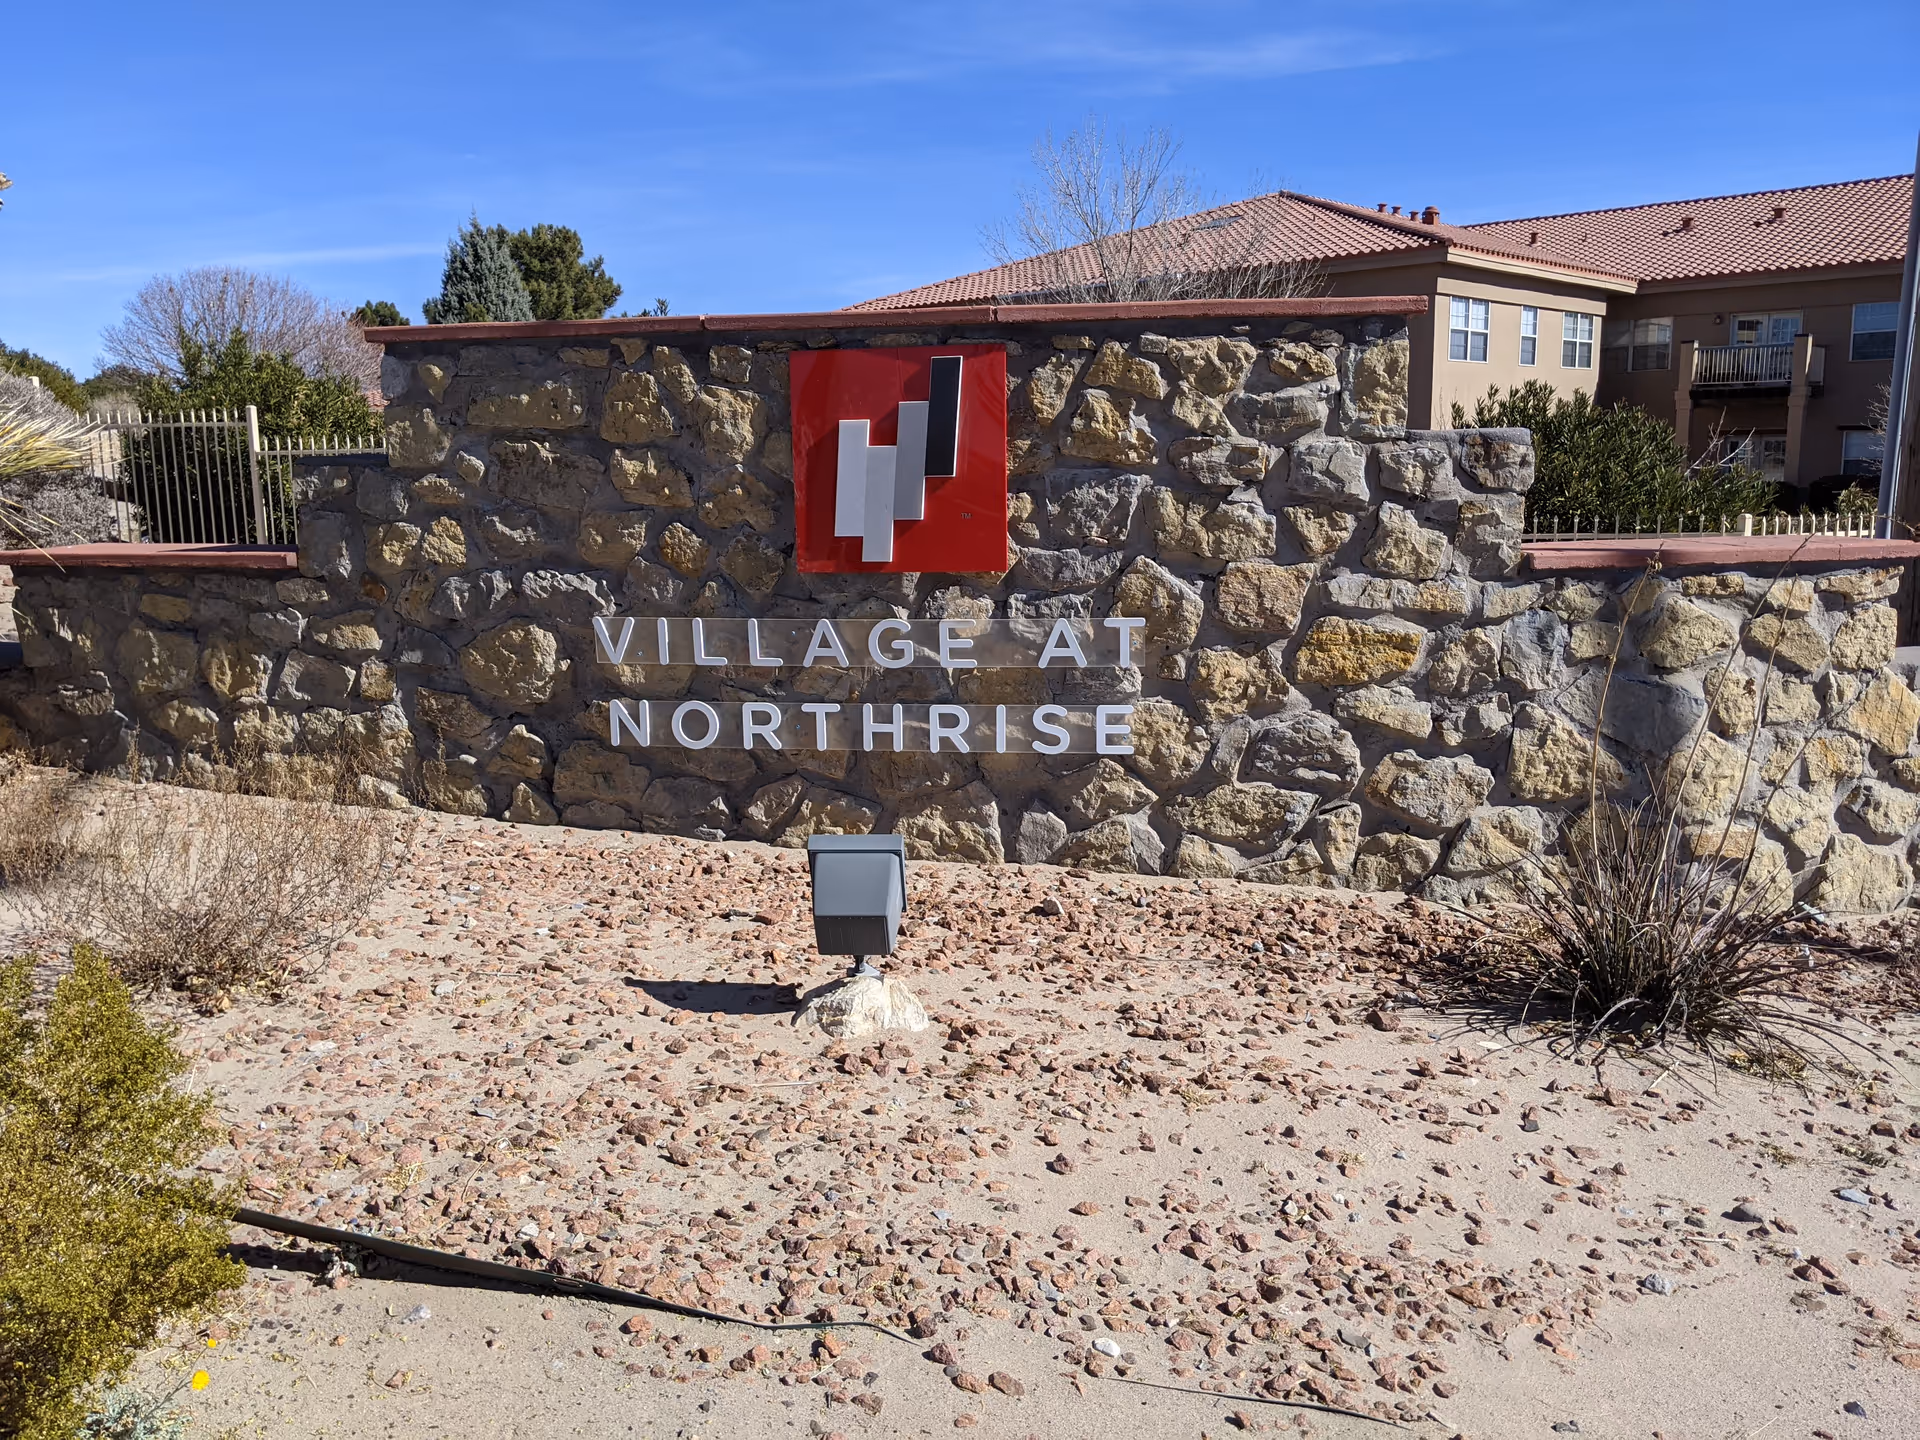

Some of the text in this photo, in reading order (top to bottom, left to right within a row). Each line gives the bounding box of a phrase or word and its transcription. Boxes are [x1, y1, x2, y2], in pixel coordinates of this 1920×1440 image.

[592, 616, 1147, 669] VILLAGE AT
[609, 700, 1135, 754] NORTHRISE
